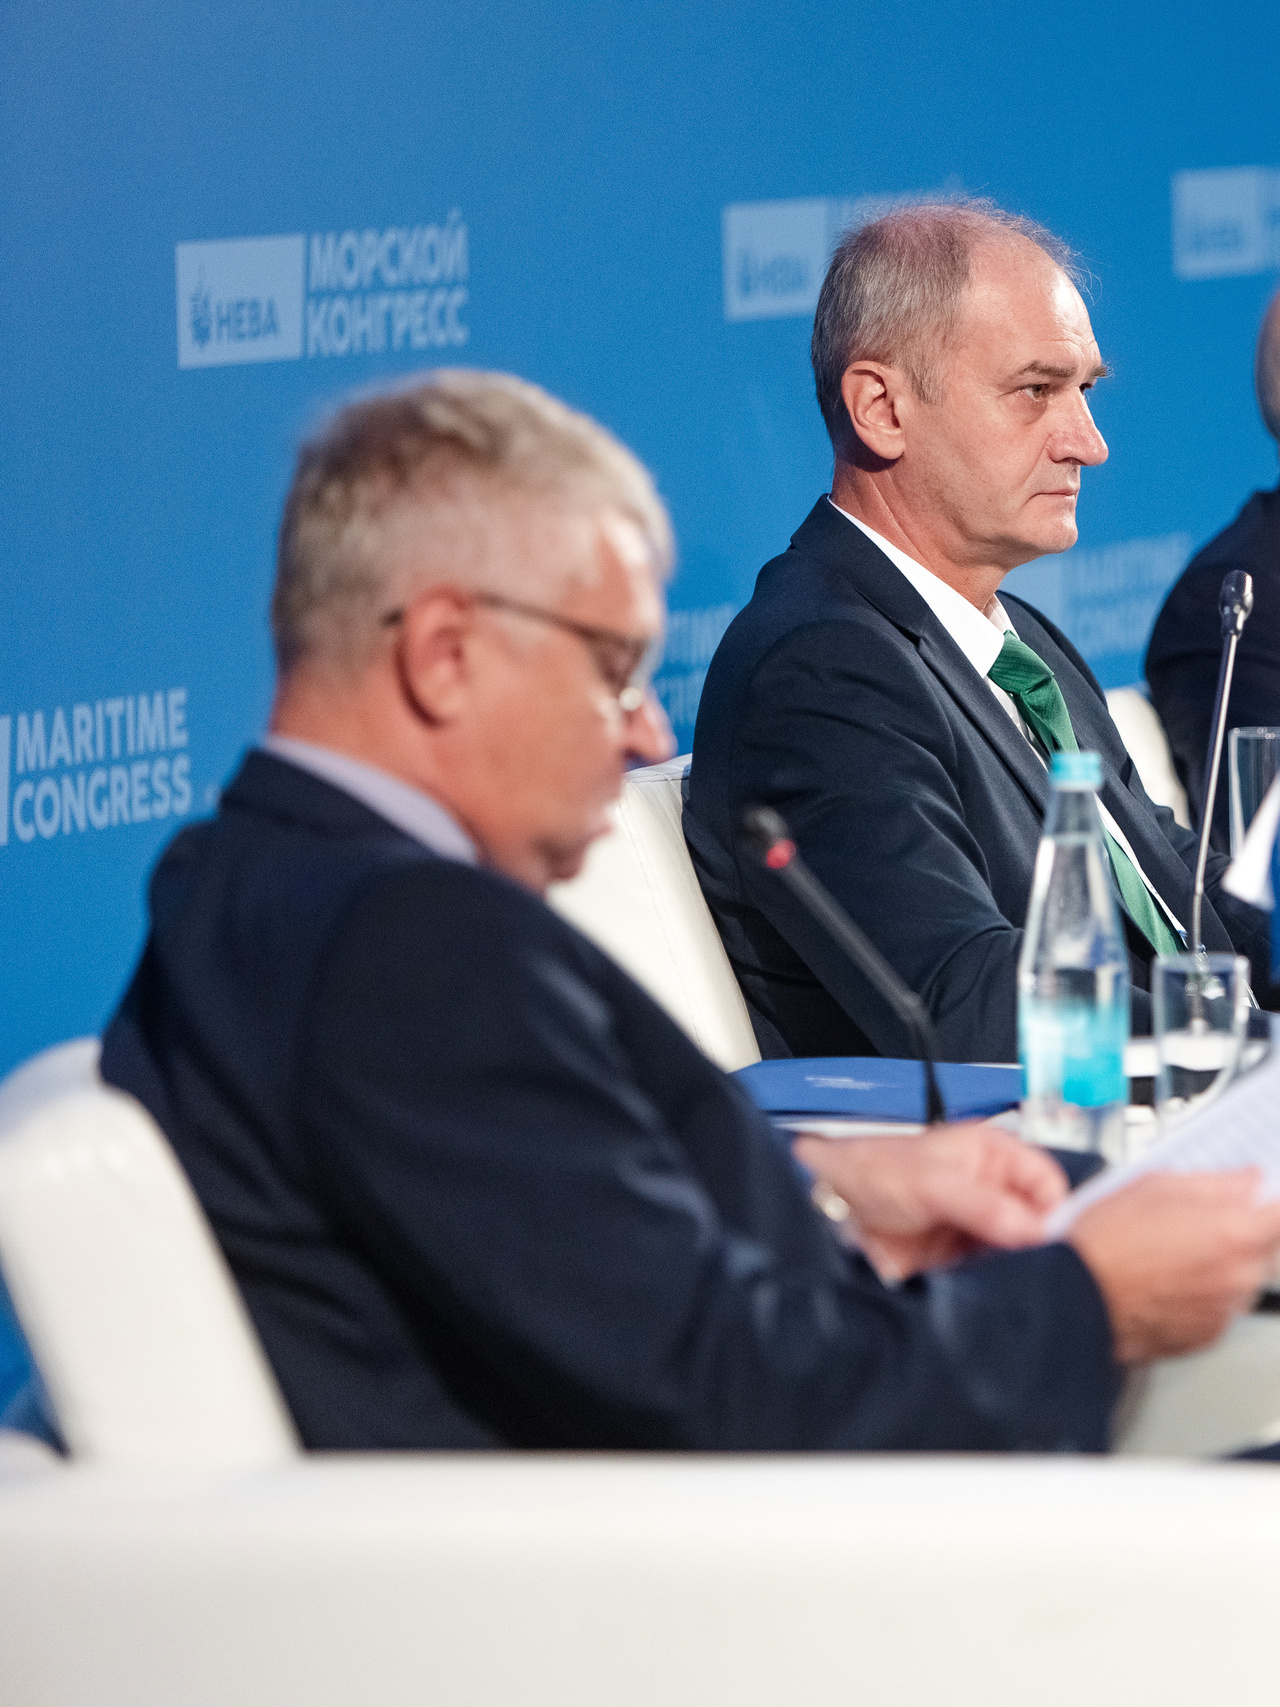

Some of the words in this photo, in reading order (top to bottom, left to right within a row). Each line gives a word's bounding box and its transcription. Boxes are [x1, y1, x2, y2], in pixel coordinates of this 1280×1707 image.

[308, 207, 469, 291] МОРСКОЙ
[211, 299, 279, 342] НЕВА
[306, 286, 470, 357] КОНГРЕСС
[16, 687, 188, 773] MARITIME
[13, 754, 193, 842] CONGRESS
